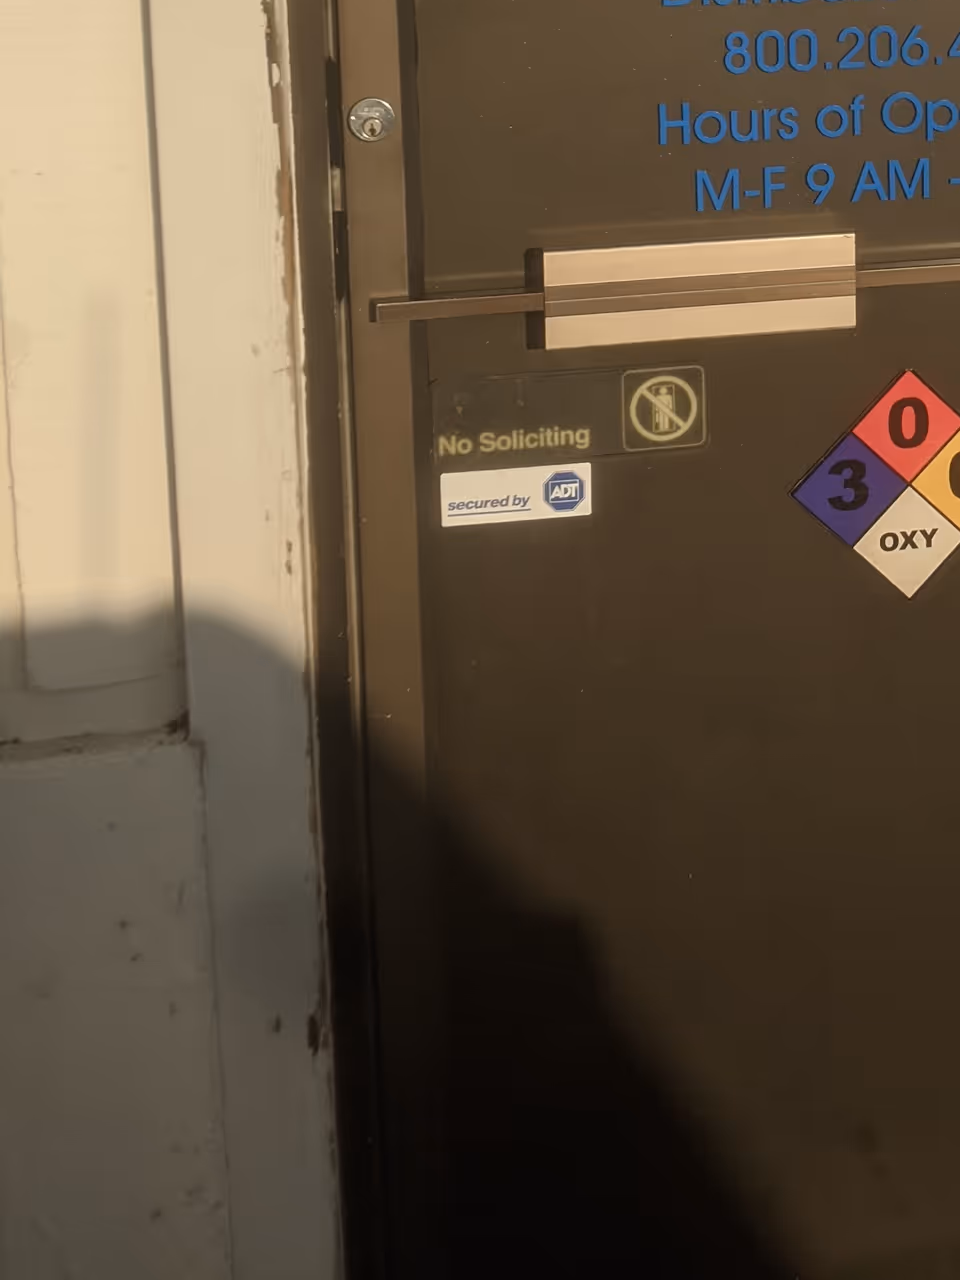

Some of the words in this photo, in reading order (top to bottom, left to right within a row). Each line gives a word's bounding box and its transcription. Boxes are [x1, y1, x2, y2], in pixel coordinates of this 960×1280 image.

[657, 101, 800, 146] Hours
[815, 95, 864, 138] of
[695, 166, 786, 212] M-F
[806, 163, 835, 205] 9
[851, 158, 931, 203] AM
[438, 434, 473, 457] No
[479, 425, 591, 452] Soliciting
[888, 396, 930, 449] 0
[447, 495, 510, 512] secured
[511, 494, 531, 508] by
[550, 482, 579, 500] ADT
[827, 459, 870, 512] 3
[879, 528, 939, 553] OXY
